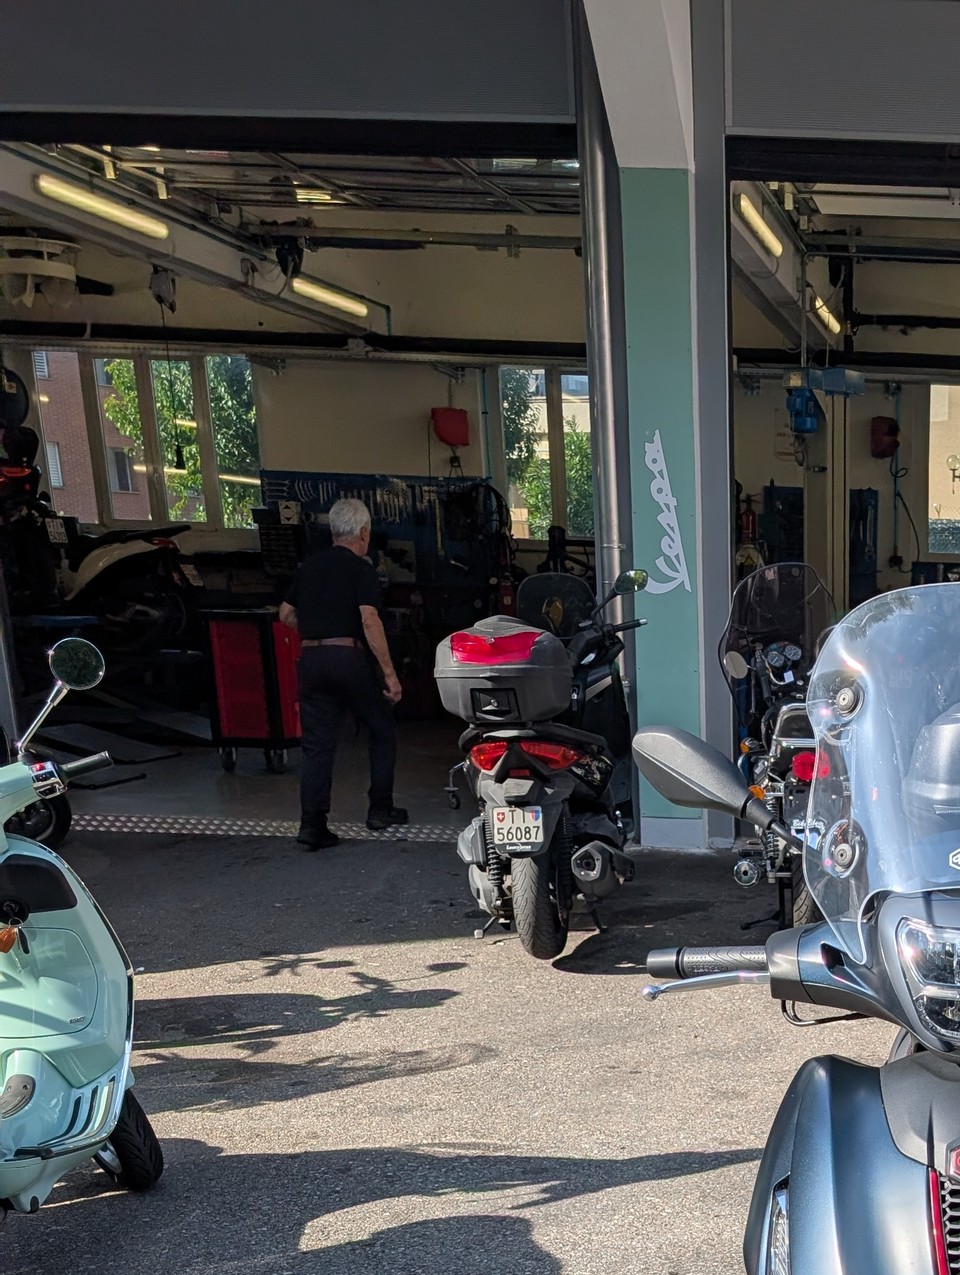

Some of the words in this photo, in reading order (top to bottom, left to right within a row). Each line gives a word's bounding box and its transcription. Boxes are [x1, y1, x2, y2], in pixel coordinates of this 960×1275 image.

[644, 429, 692, 595] Vespa
[508, 808, 526, 824] TI
[496, 825, 540, 842] 56087
